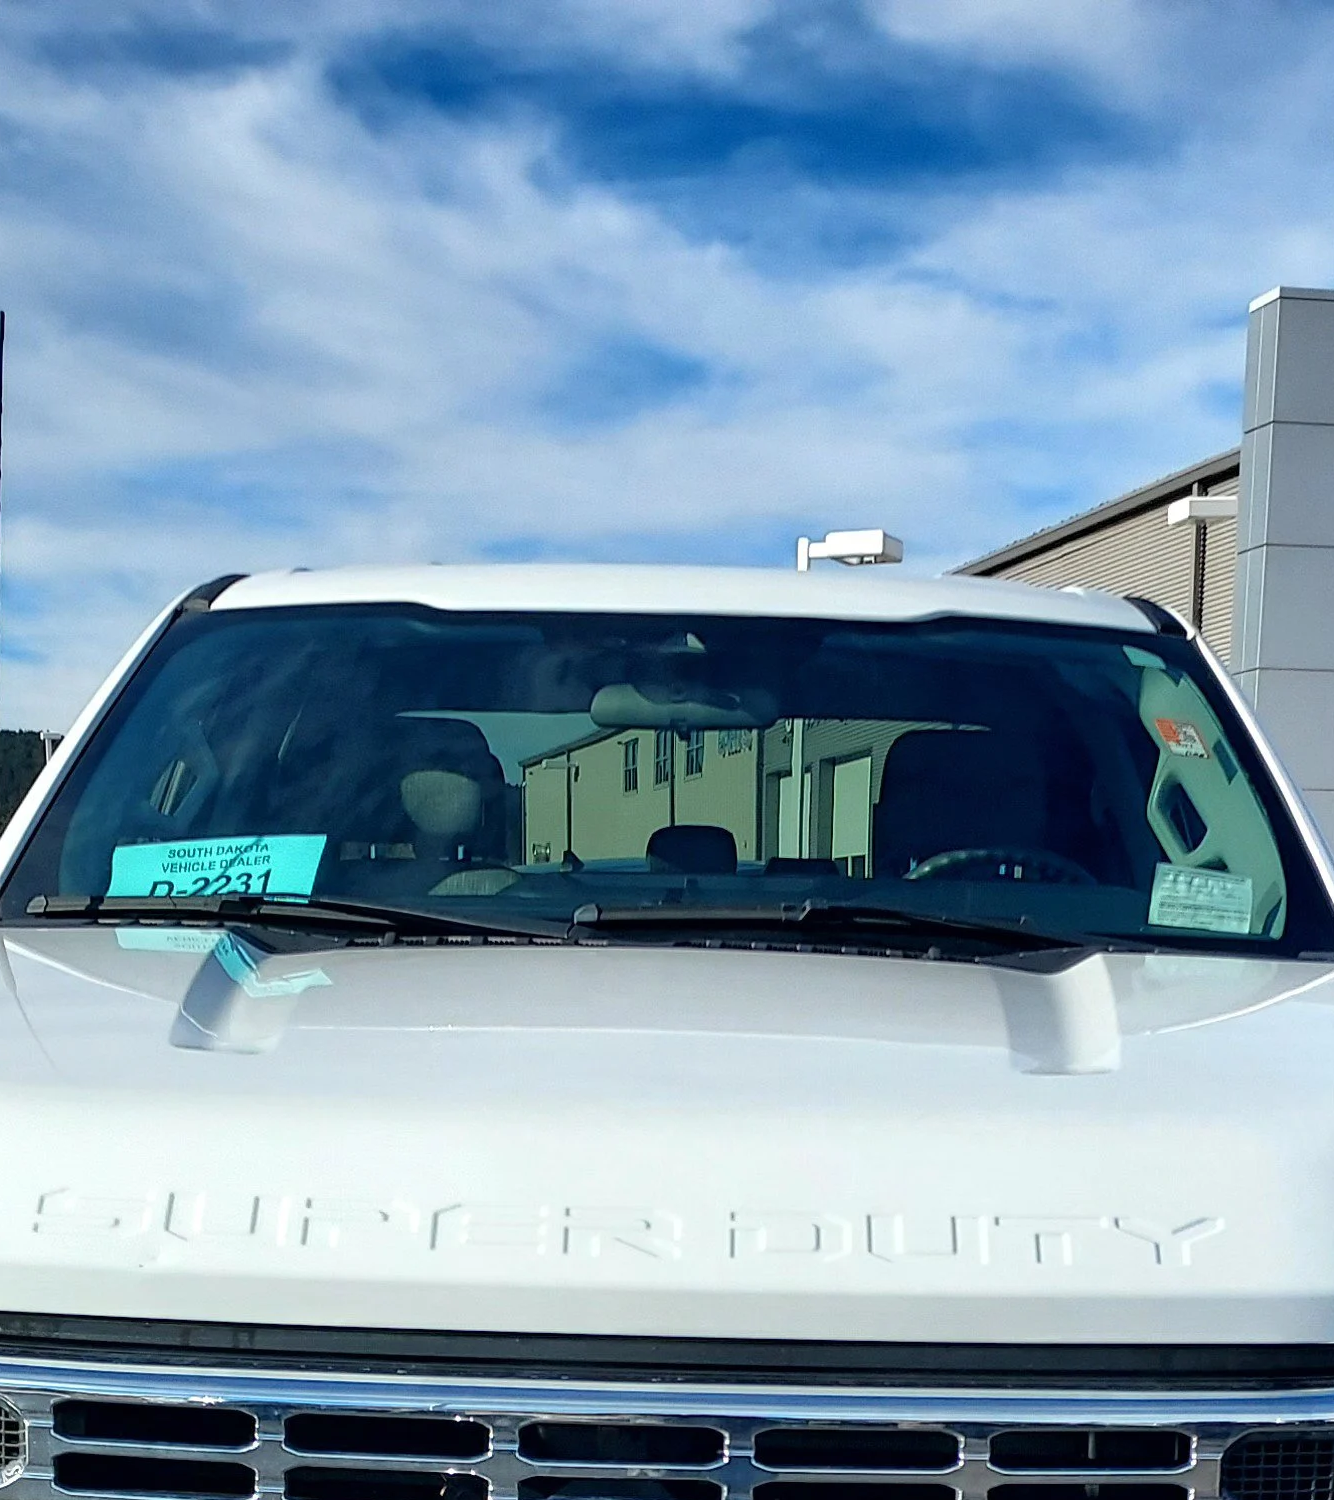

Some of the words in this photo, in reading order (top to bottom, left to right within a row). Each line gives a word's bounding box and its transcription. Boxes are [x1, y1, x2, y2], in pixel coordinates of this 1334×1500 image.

[167, 846, 213, 859] SOUTH
[216, 843, 269, 856] DAKOTA
[161, 860, 216, 874] VEHICLE
[219, 855, 271, 869] DEALER
[30, 1188, 683, 1260] SUPER
[728, 1209, 1227, 1266] DUTY
